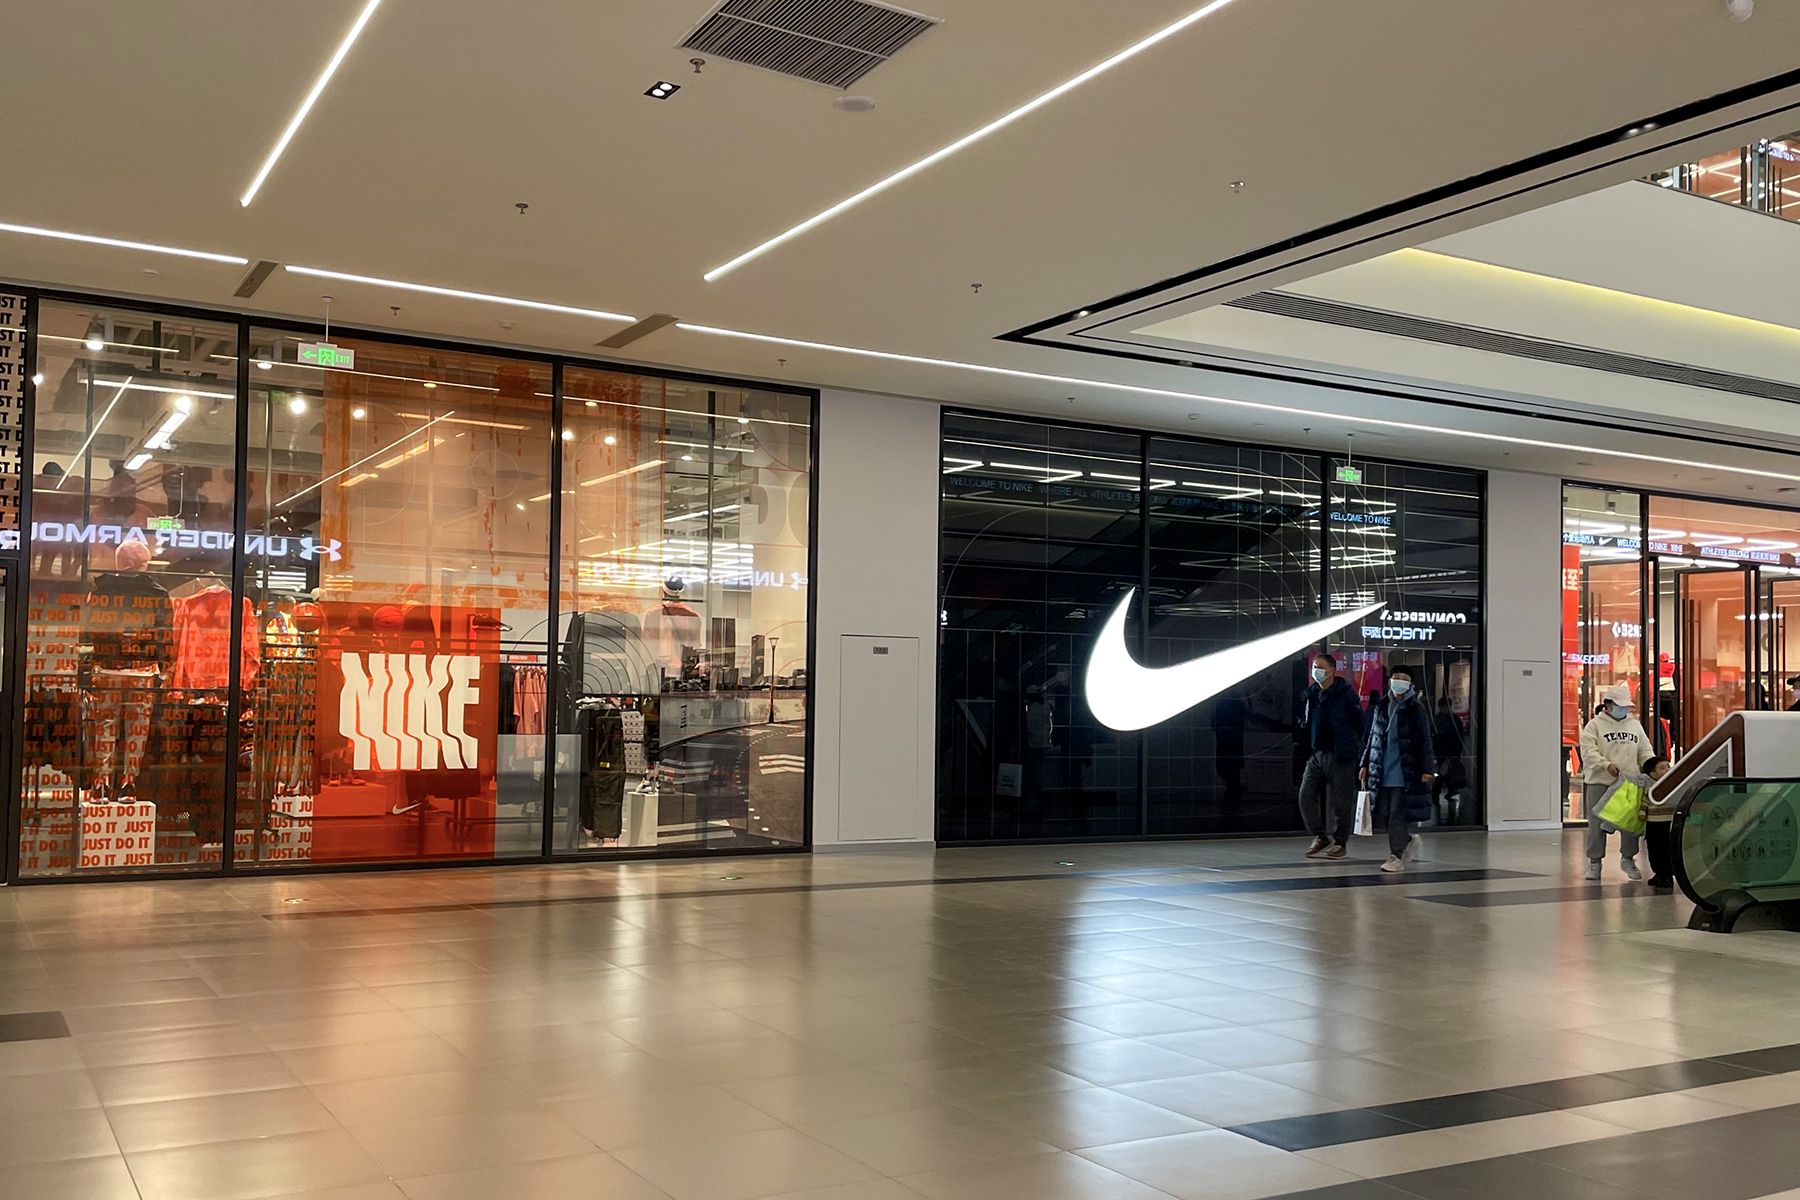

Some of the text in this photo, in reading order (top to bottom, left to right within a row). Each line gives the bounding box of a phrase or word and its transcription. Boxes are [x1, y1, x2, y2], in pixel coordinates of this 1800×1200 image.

[0, 296, 16, 309] ST
[0, 313, 12, 325] IT
[0, 330, 15, 342] ST
[0, 346, 11, 358] IT
[336, 355, 350, 364] EXIT
[950, 476, 996, 490] WELCOME
[1000, 479, 1010, 491] TO
[1013, 482, 1033, 493] NIKE
[1040, 484, 1071, 496] WERE
[1073, 488, 1088, 498] ALL
[1364, 514, 1374, 524] TO
[1375, 514, 1391, 526] NIKE
[1655, 543, 1667, 551] NIKE
[57, 593, 86, 606] JUST
[91, 595, 109, 607] DO
[113, 595, 125, 607] IT
[132, 596, 159, 608] JUST
[29, 609, 43, 620] ST
[47, 609, 66, 621] DO
[71, 611, 80, 622] IT
[90, 611, 119, 623] JUST
[123, 612, 142, 624] DO
[145, 613, 156, 624] IT
[36, 626, 47, 638] IT
[27, 642, 41, 653] ST
[45, 642, 66, 655] DO
[122, 644, 141, 656] DO
[145, 645, 157, 656] IT
[195, 646, 213, 658] DO
[34, 658, 47, 670] IT
[202, 662, 228, 674] JUST
[265, 678, 281, 690] DO
[285, 678, 297, 690] IT
[43, 708, 63, 720] DO
[161, 708, 190, 721] JUST
[193, 709, 212, 721] DO
[264, 709, 280, 721] DO
[285, 709, 296, 721] IT
[339, 652, 480, 770] NIKE
[32, 724, 44, 737] IT
[128, 724, 156, 737] JUST
[160, 724, 180, 737] DO
[182, 724, 194, 737] IT
[200, 724, 227, 737] JUST
[271, 725, 297, 736] JUST
[301, 725, 316, 736] DO
[86, 740, 115, 753] JUST
[160, 740, 188, 753] JUST
[191, 740, 210, 753] DO
[262, 740, 279, 752] DO
[41, 773, 61, 786] DO
[83, 805, 112, 818] JUST
[117, 805, 136, 817] DO
[140, 805, 151, 817] IT
[282, 801, 293, 813] IT
[82, 822, 102, 834] DO
[106, 821, 117, 834] IT
[124, 821, 154, 834] JUST
[270, 817, 294, 828] JUST
[81, 837, 150, 851] JUST DO IT
[260, 833, 277, 845] DO
[281, 832, 292, 844] IT
[21, 839, 73, 853] ST DO IT
[81, 853, 152, 867] DO IT JUST
[156, 850, 222, 864] DO IT JUST
[267, 848, 292, 860] JUST
[297, 847, 312, 859] DO
[28, 856, 77, 869] IT JUST
